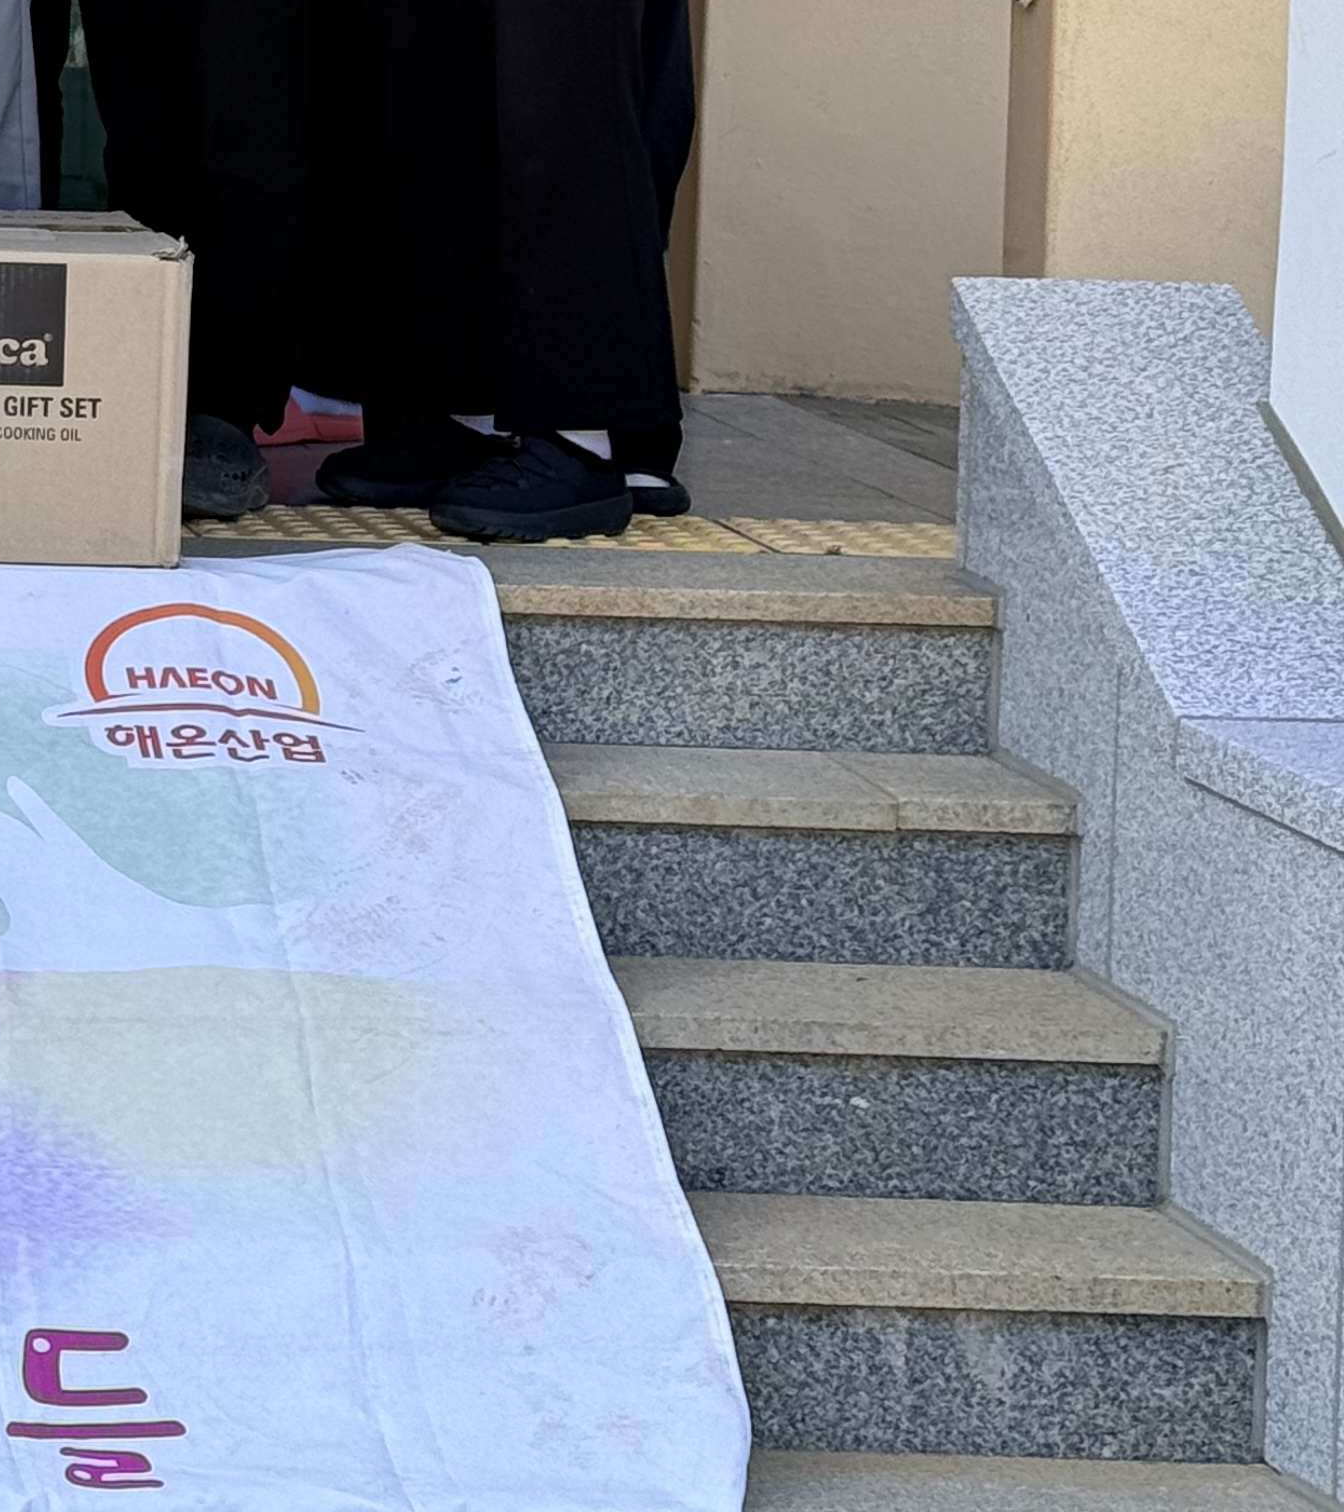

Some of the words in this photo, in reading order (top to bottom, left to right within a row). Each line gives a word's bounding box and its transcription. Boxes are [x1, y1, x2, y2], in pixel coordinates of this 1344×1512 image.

[4, 396, 54, 418] GIFT
[59, 397, 102, 419] SET
[61, 426, 82, 442] OIL
[126, 666, 278, 701] HAEON
[104, 724, 327, 763] 해온산업
